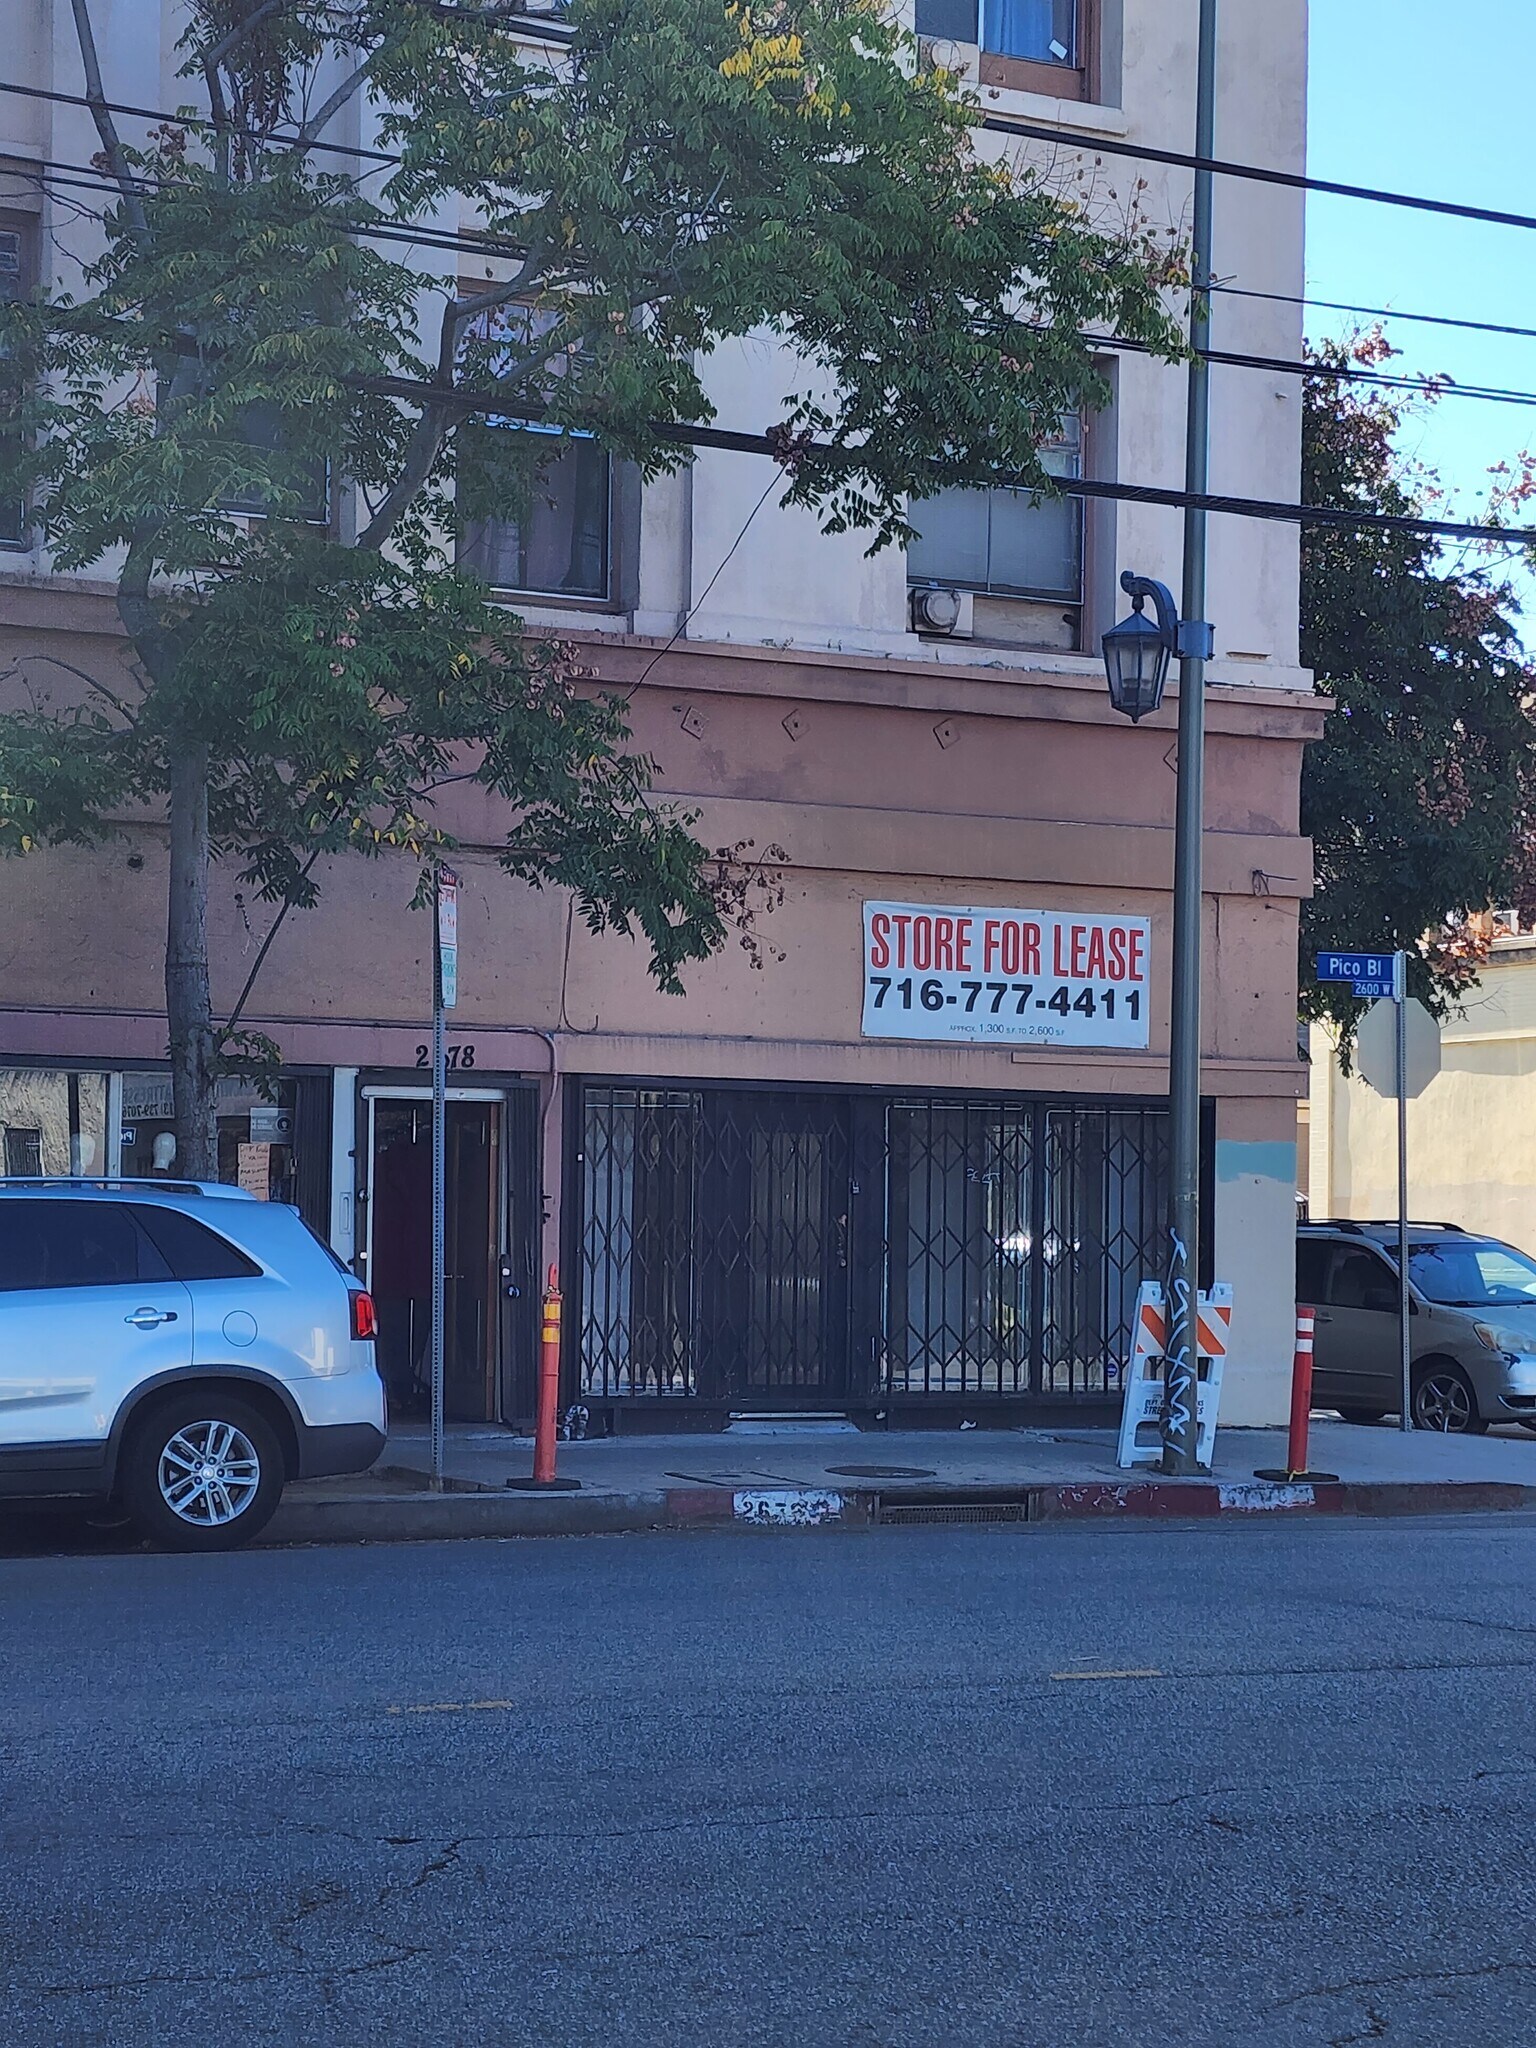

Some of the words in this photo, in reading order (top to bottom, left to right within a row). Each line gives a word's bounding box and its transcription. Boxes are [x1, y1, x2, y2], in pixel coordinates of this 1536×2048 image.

[871, 913, 973, 972] STORE
[983, 920, 1041, 976] FOR
[1053, 924, 1144, 982] LEASE
[1329, 957, 1360, 976] Pico
[1367, 958, 1381, 977] Bl
[869, 976, 1140, 1020] 716-777-4411
[1355, 982, 1379, 995] 2600
[1382, 983, 1390, 995] W
[979, 1023, 1005, 1034] 1,300
[1028, 1025, 1055, 1036] 2,600
[416, 1044, 475, 1068] 278
